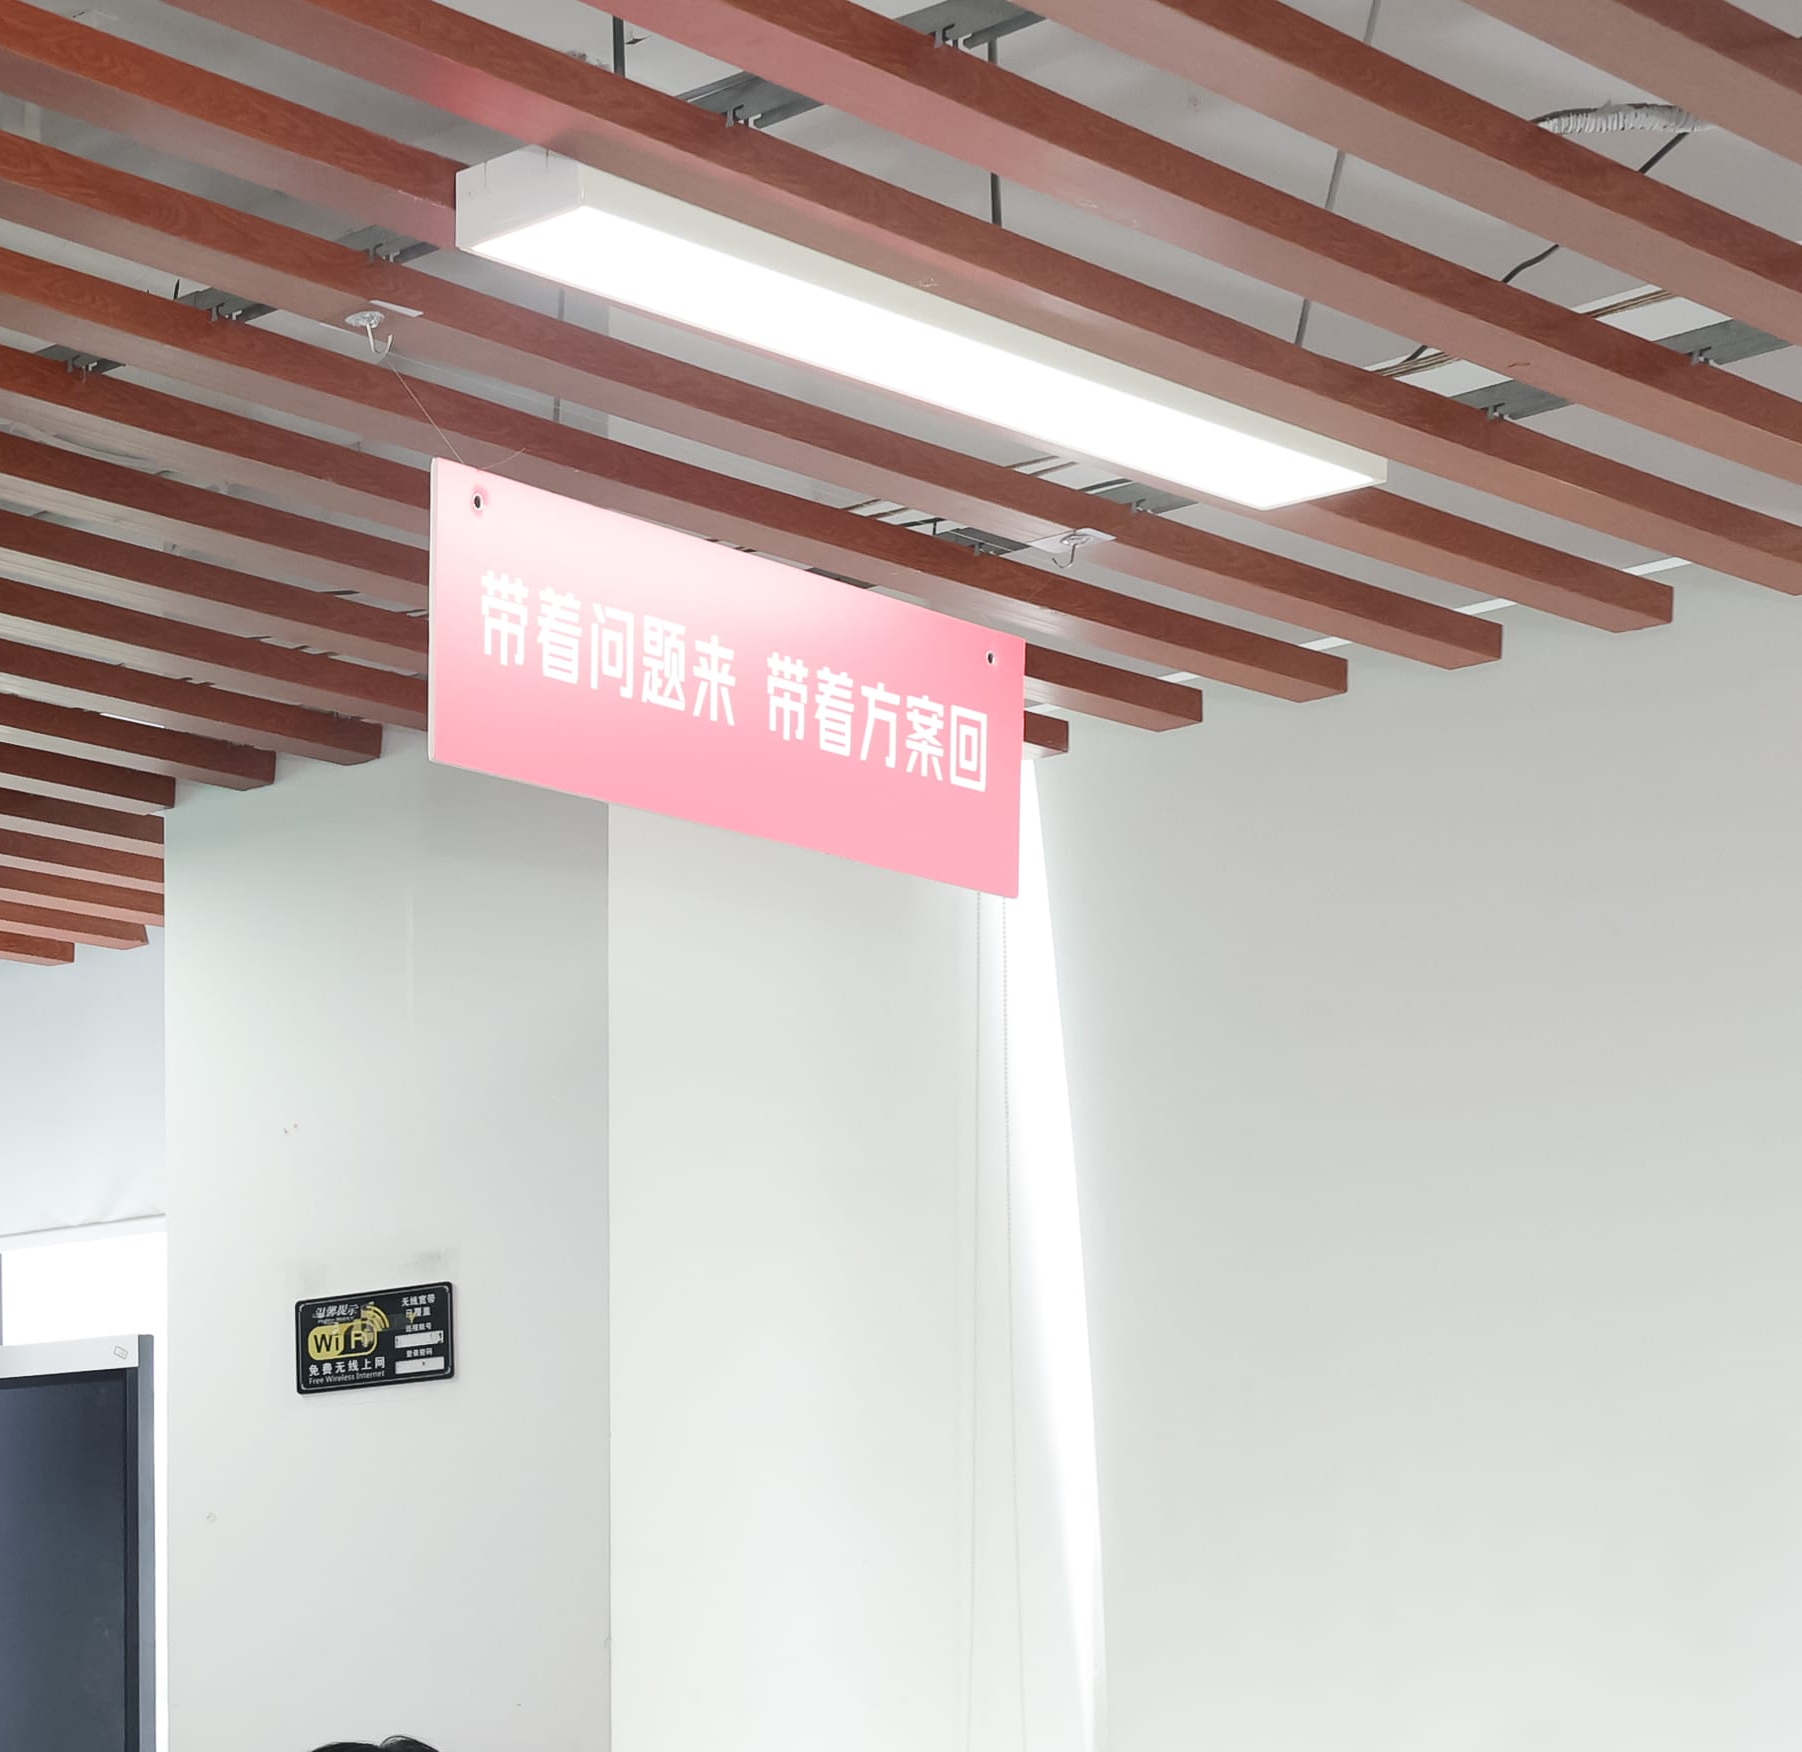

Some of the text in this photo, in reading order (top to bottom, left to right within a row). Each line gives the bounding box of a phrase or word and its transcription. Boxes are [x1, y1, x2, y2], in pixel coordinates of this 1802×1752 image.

[481, 570, 988, 793] 带着问题来 带着方案回
[308, 1356, 385, 1377] 免费无线上网
[308, 1370, 385, 1385] Free Wireless Internet
